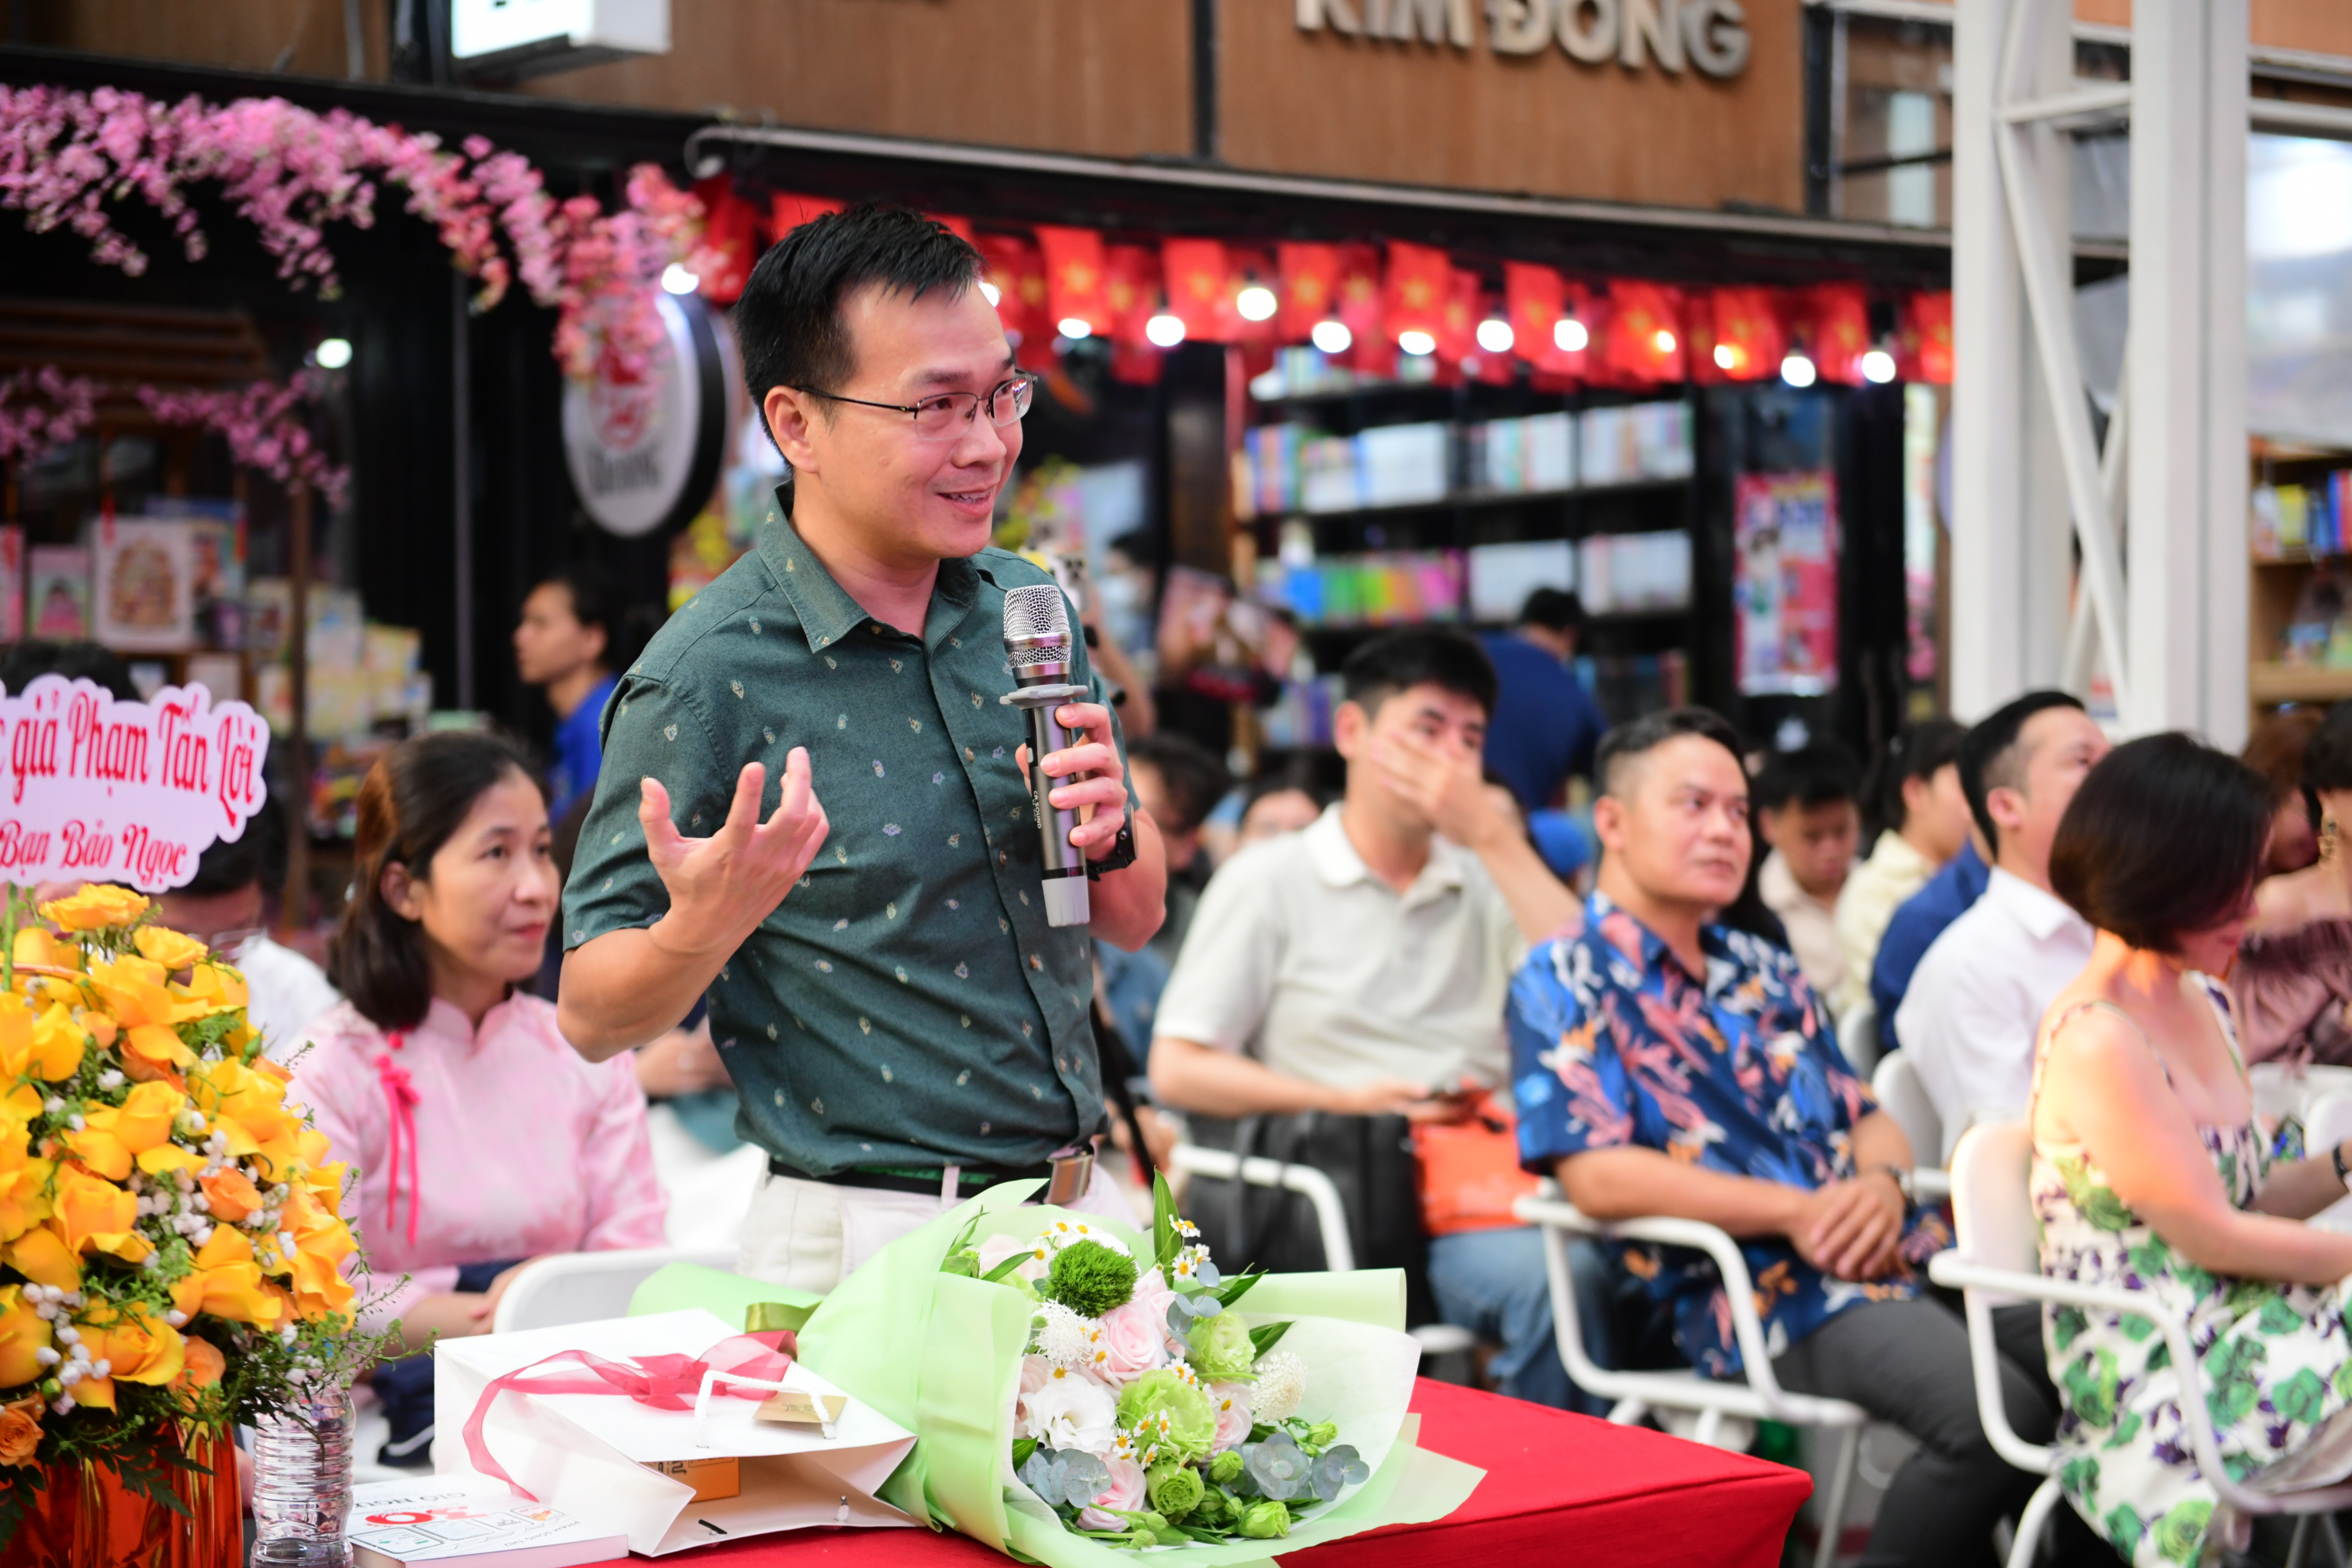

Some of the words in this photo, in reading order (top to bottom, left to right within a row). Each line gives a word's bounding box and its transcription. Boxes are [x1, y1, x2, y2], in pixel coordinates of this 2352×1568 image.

[12, 689, 60, 805] giả
[68, 691, 149, 797] Phạm
[158, 694, 210, 793] Tấn
[0, 820, 51, 877] Bạn
[61, 819, 114, 869] Bảo
[122, 824, 188, 886] Ngọc
